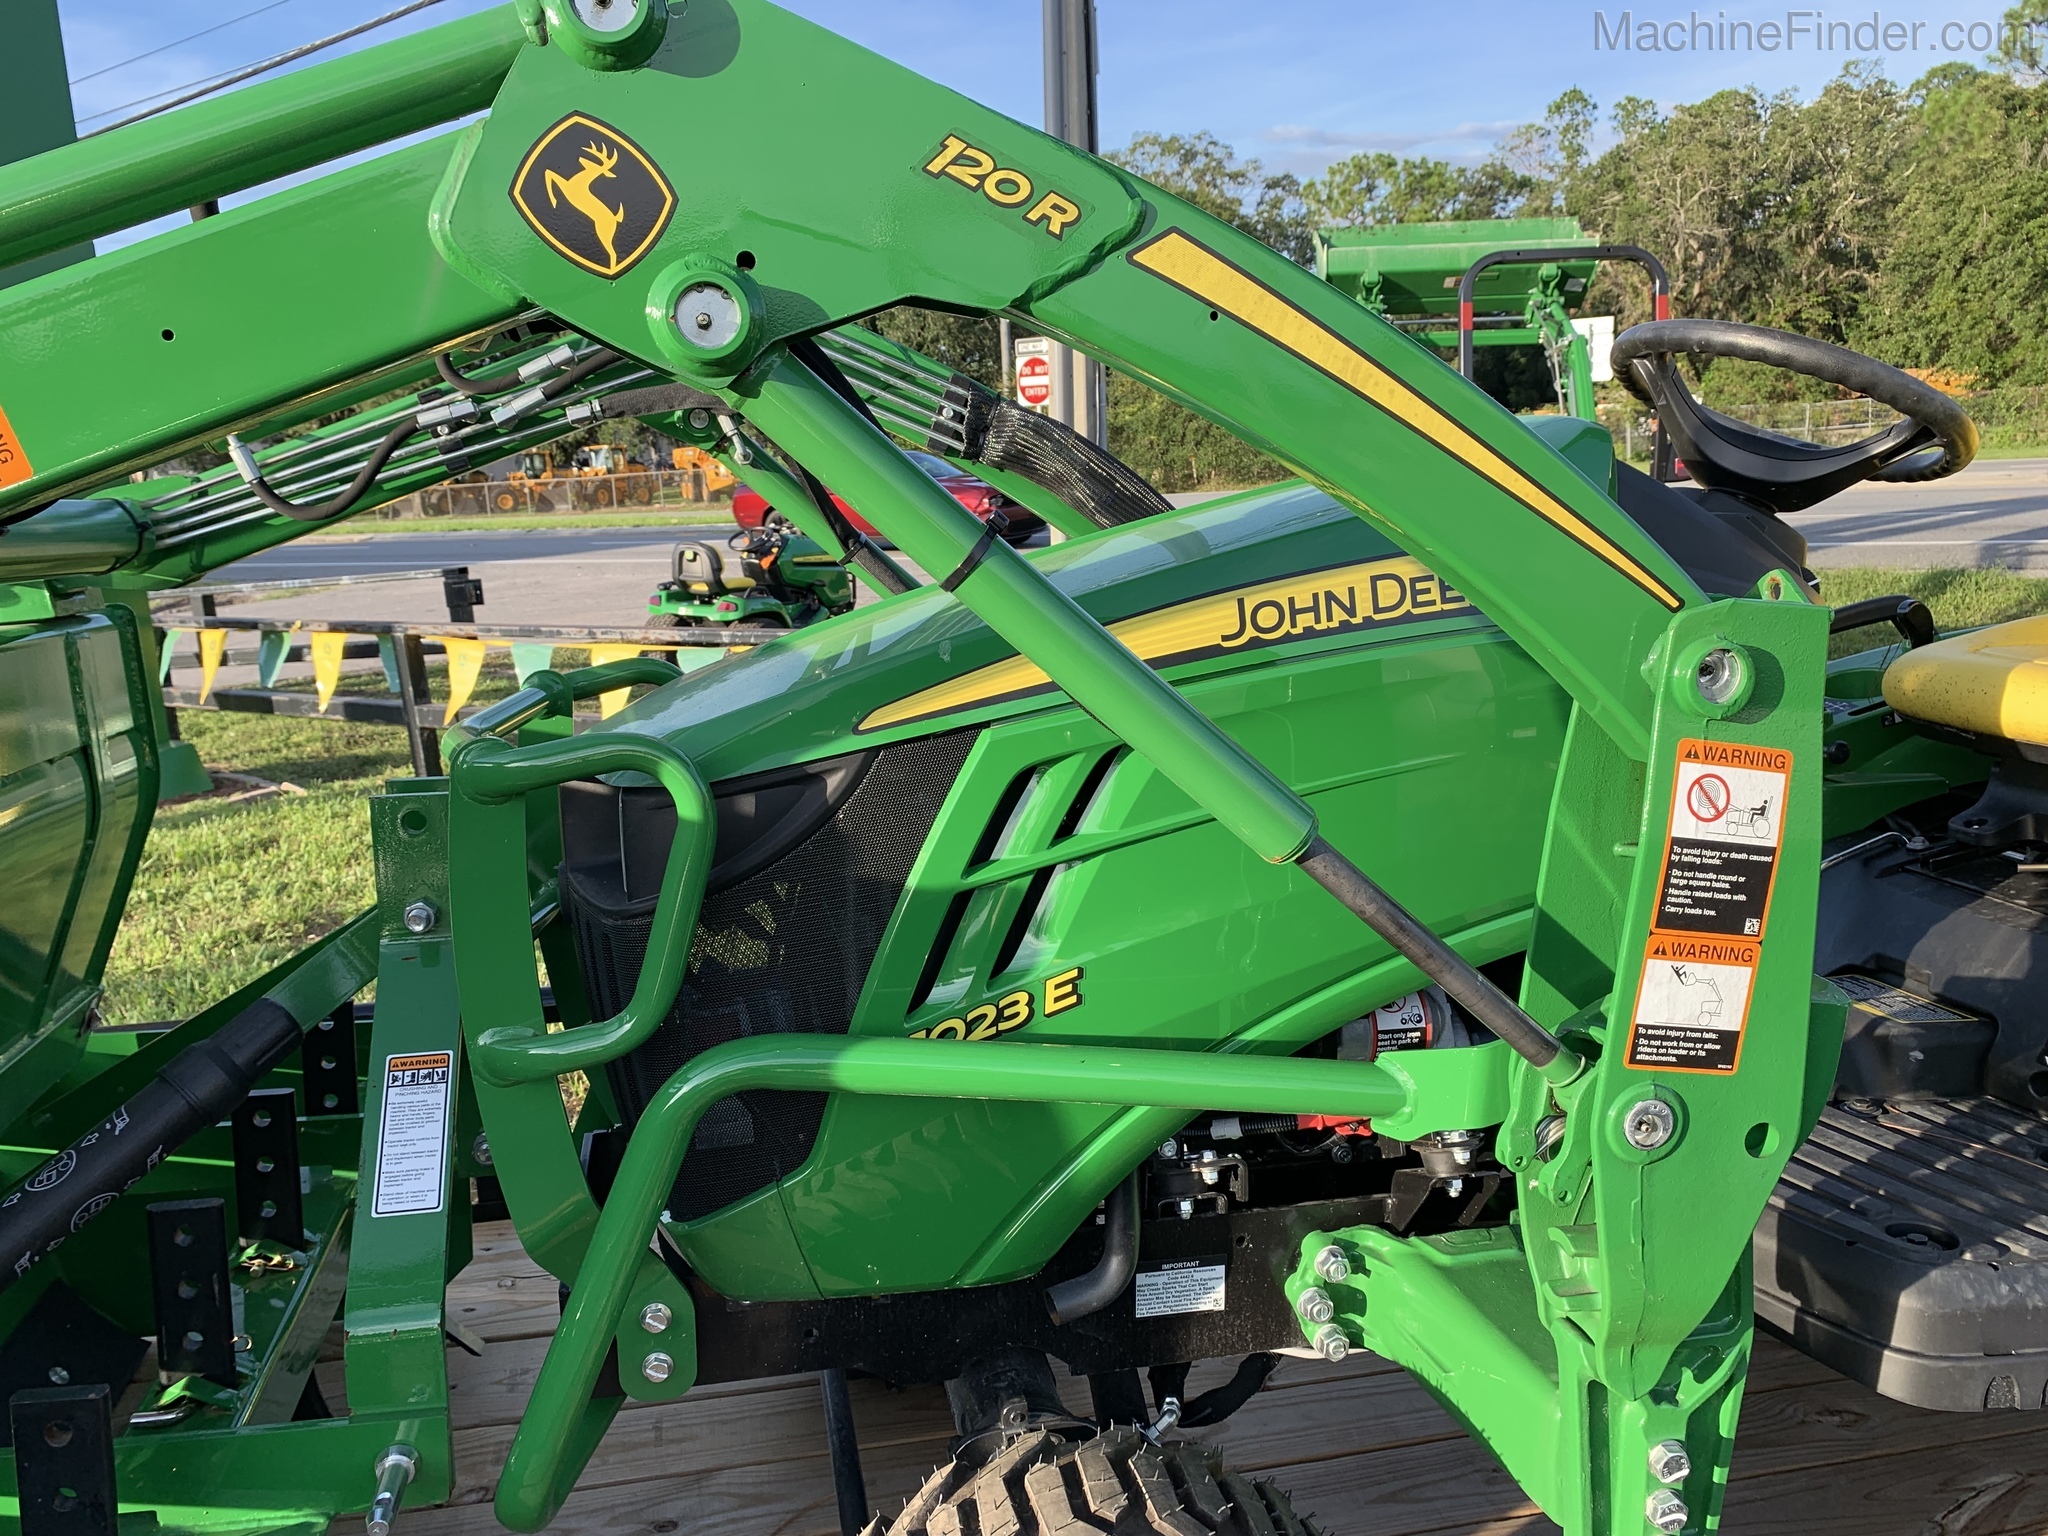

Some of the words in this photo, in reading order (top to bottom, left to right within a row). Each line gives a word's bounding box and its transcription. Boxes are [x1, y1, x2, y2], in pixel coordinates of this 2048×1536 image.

[922, 132, 1035, 209] 120
[1022, 189, 1083, 242] R
[1022, 366, 1032, 375] DO
[1034, 364, 1048, 374] NOT
[1025, 386, 1047, 396] ENTER
[1220, 585, 1362, 645] JOHN
[1368, 571, 1468, 619] DEE
[1704, 745, 1786, 770] WARNING
[1701, 849, 1720, 858] injury
[1670, 854, 1679, 863] by
[1680, 855, 1701, 864] falling
[1670, 877, 1687, 886] large
[1665, 905, 1683, 914] Carry
[1671, 942, 1754, 963] WARNING
[907, 990, 1036, 1042] 023
[1043, 966, 1085, 1018] E
[1666, 1029, 1684, 1038] injury
[400, 1058, 446, 1067] WARNING
[1161, 1261, 1199, 1270] IMPORTANT
